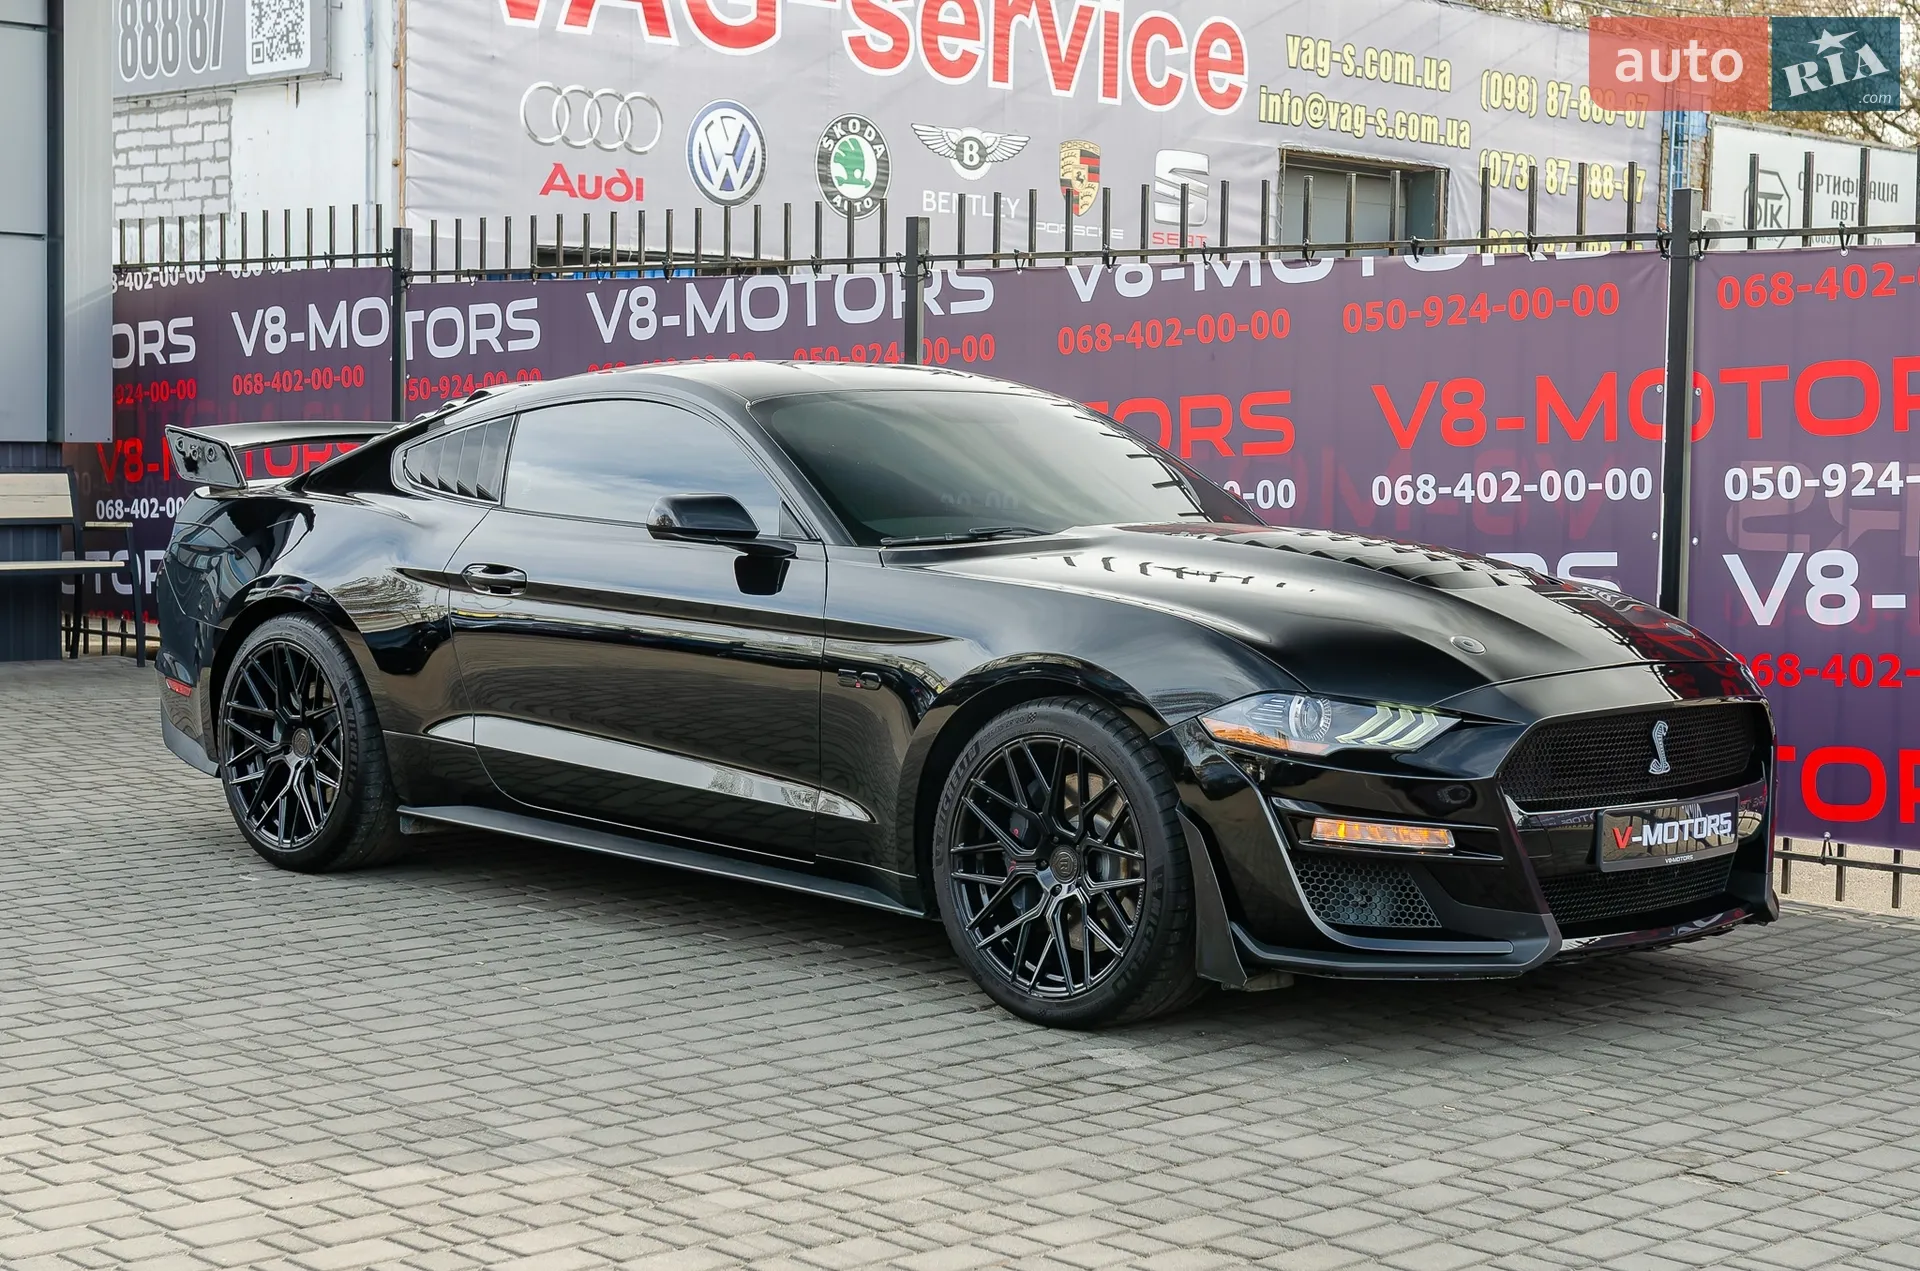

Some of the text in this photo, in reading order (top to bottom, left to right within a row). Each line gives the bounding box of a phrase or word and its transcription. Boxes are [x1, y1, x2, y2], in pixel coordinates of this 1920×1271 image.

[1285, 33, 1452, 93] vag-s.com.ua
[1481, 68, 1538, 118] (098)
[1258, 85, 1472, 150] info@vag-s.com.ua
[539, 162, 644, 201] Audi
[1342, 281, 1620, 334] 050-924-00-00
[1717, 261, 1920, 310] 068-402-
[1057, 308, 1292, 355] 068-402-00-00
[231, 363, 365, 397] 068-402-00-00
[1371, 466, 1653, 507] 068-402-00-00
[1721, 549, 1920, 627] V8-
[1733, 652, 1920, 689] 68-402-
[1612, 811, 1733, 850] V-MOTORS
